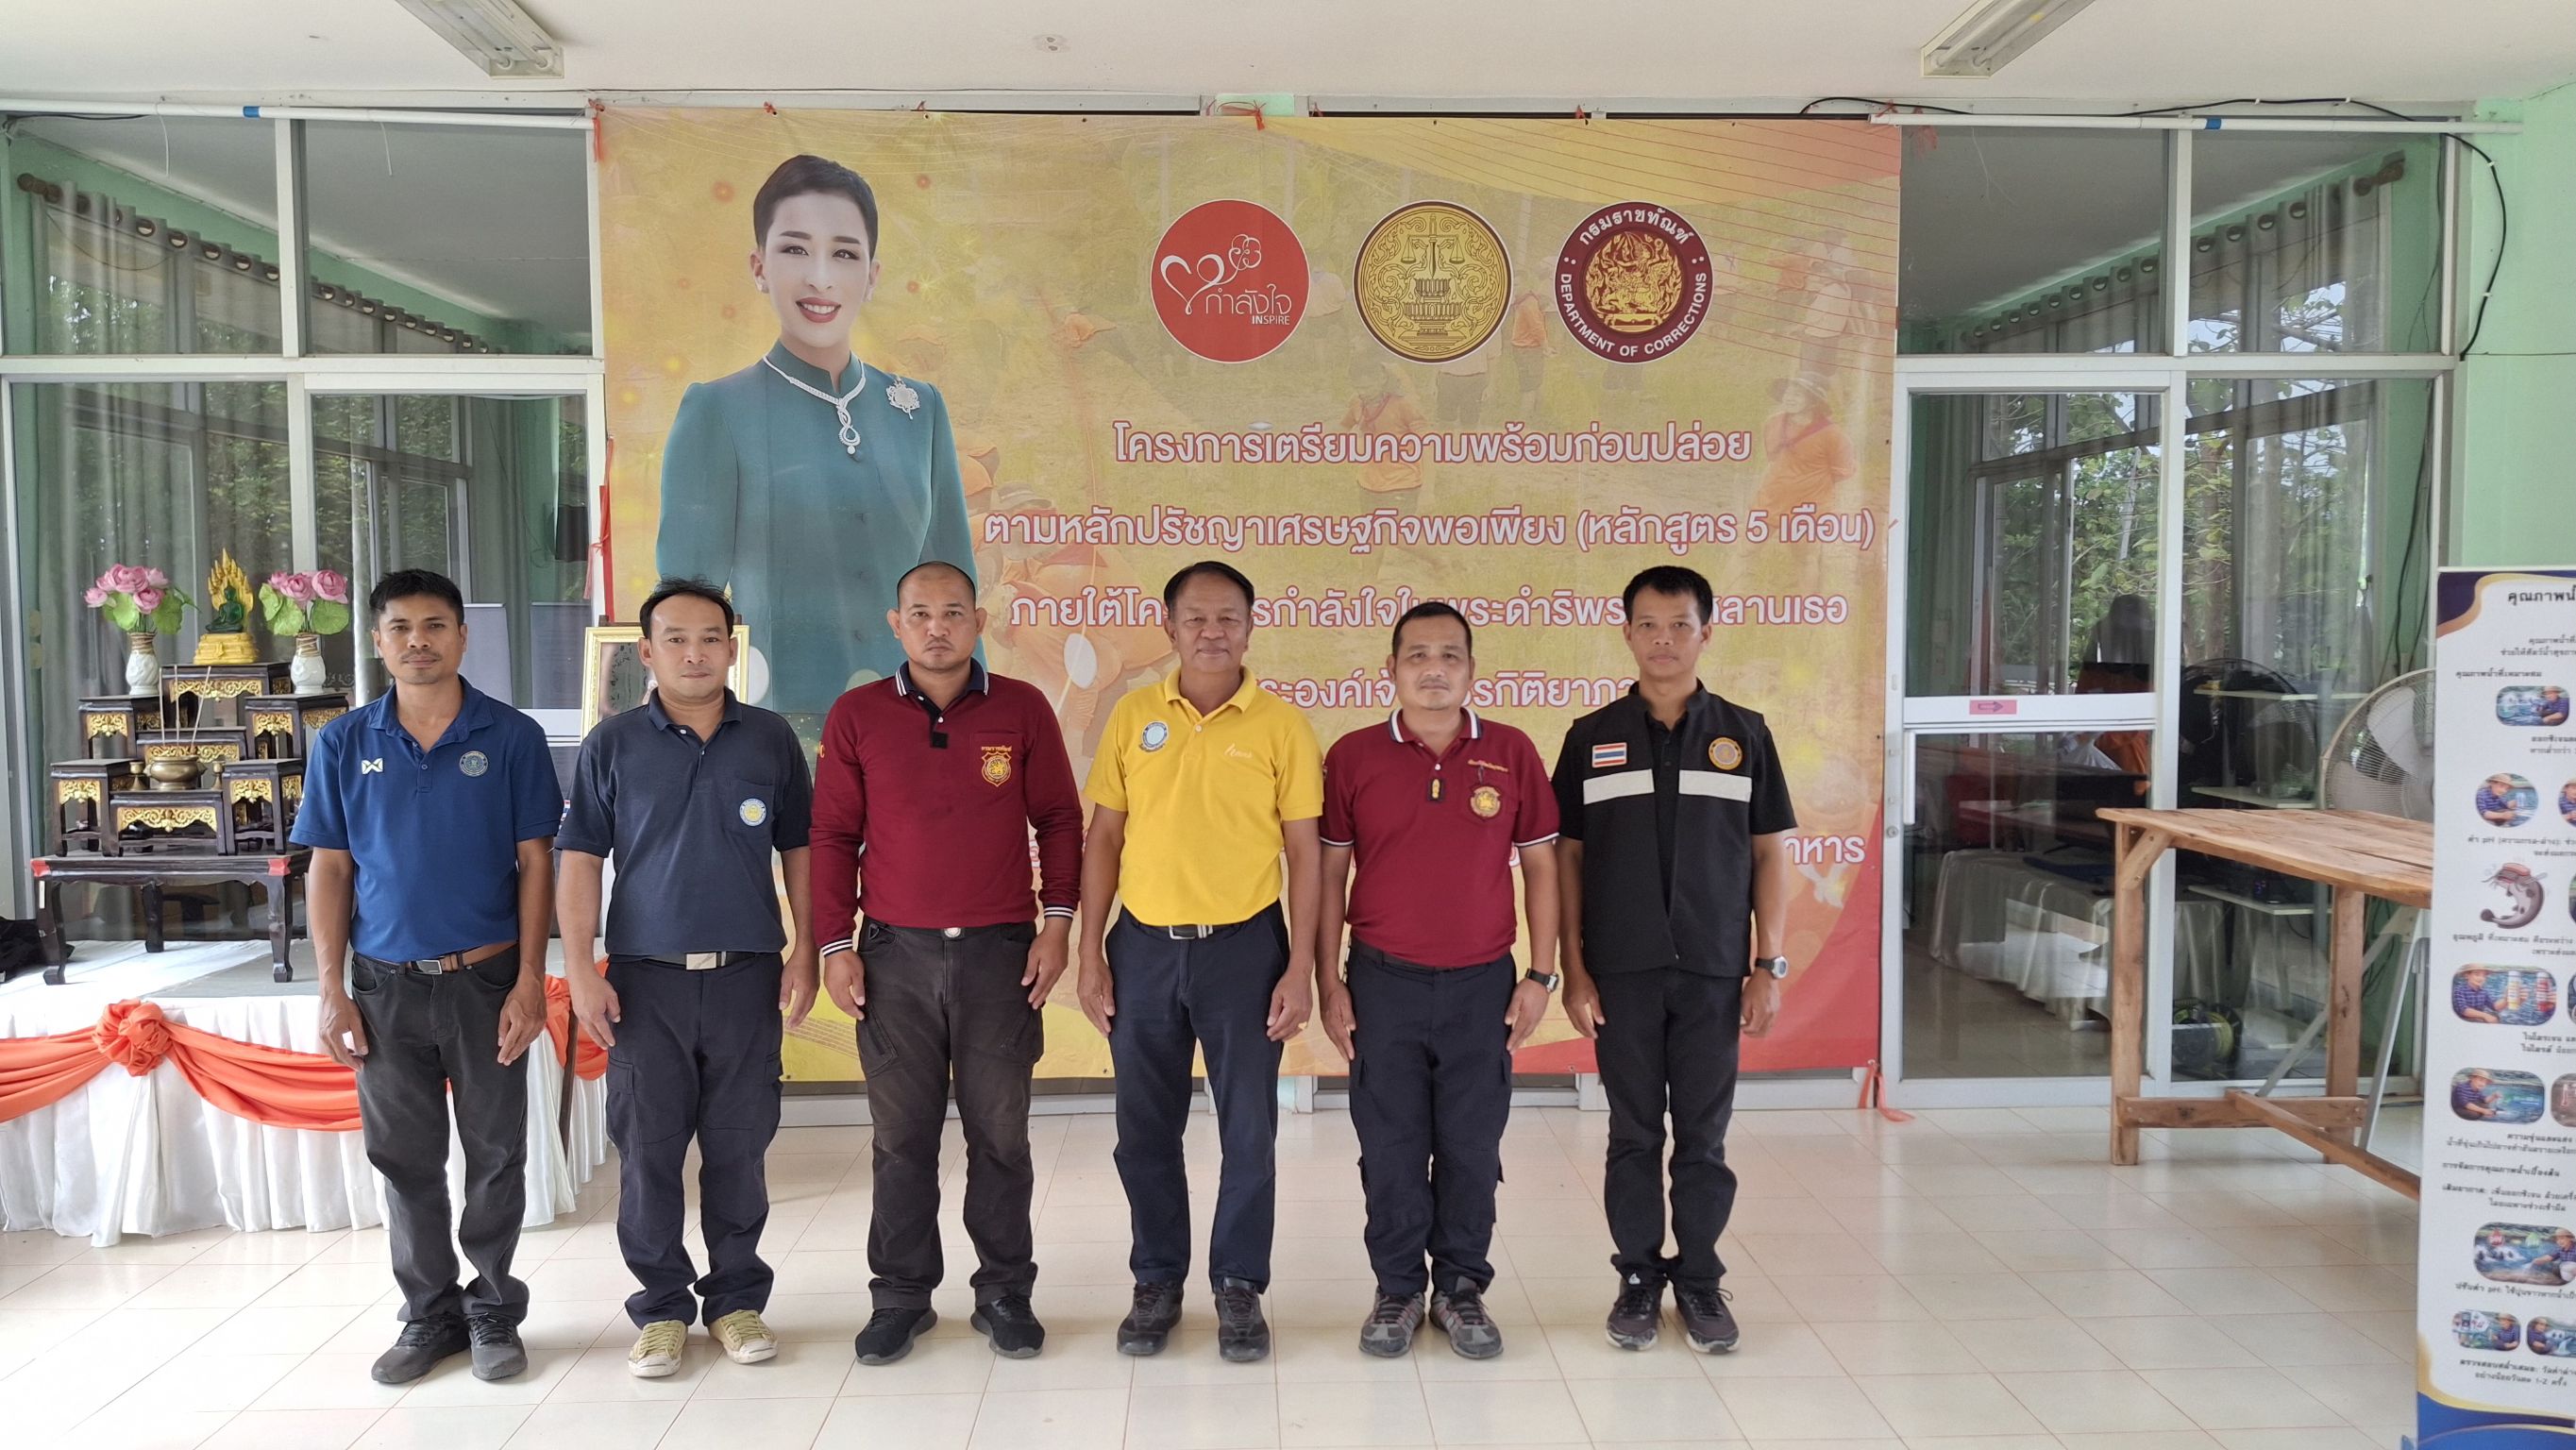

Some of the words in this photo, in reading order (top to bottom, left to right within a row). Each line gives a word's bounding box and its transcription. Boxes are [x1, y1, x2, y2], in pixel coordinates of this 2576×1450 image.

[1579, 207, 1694, 245] กรมราชทัณฑ์
[1205, 283, 1292, 314] กำลังใจ
[1560, 273, 1615, 353] DEPARTMENT
[1619, 346, 1638, 357] OF
[1643, 272, 1707, 355] CORRECTIONS
[1252, 315, 1290, 326] INSPIRE
[1114, 421, 1751, 464] โครงการเตรียมความพร้อมก่อนปล่อย
[985, 504, 1567, 554] ตามหลักปรัชญาเศรษฐกิจพอเพียง
[1576, 504, 1738, 555] (หลักสูตร
[1745, 511, 1768, 544] 5
[1778, 503, 1876, 550] เดือน)
